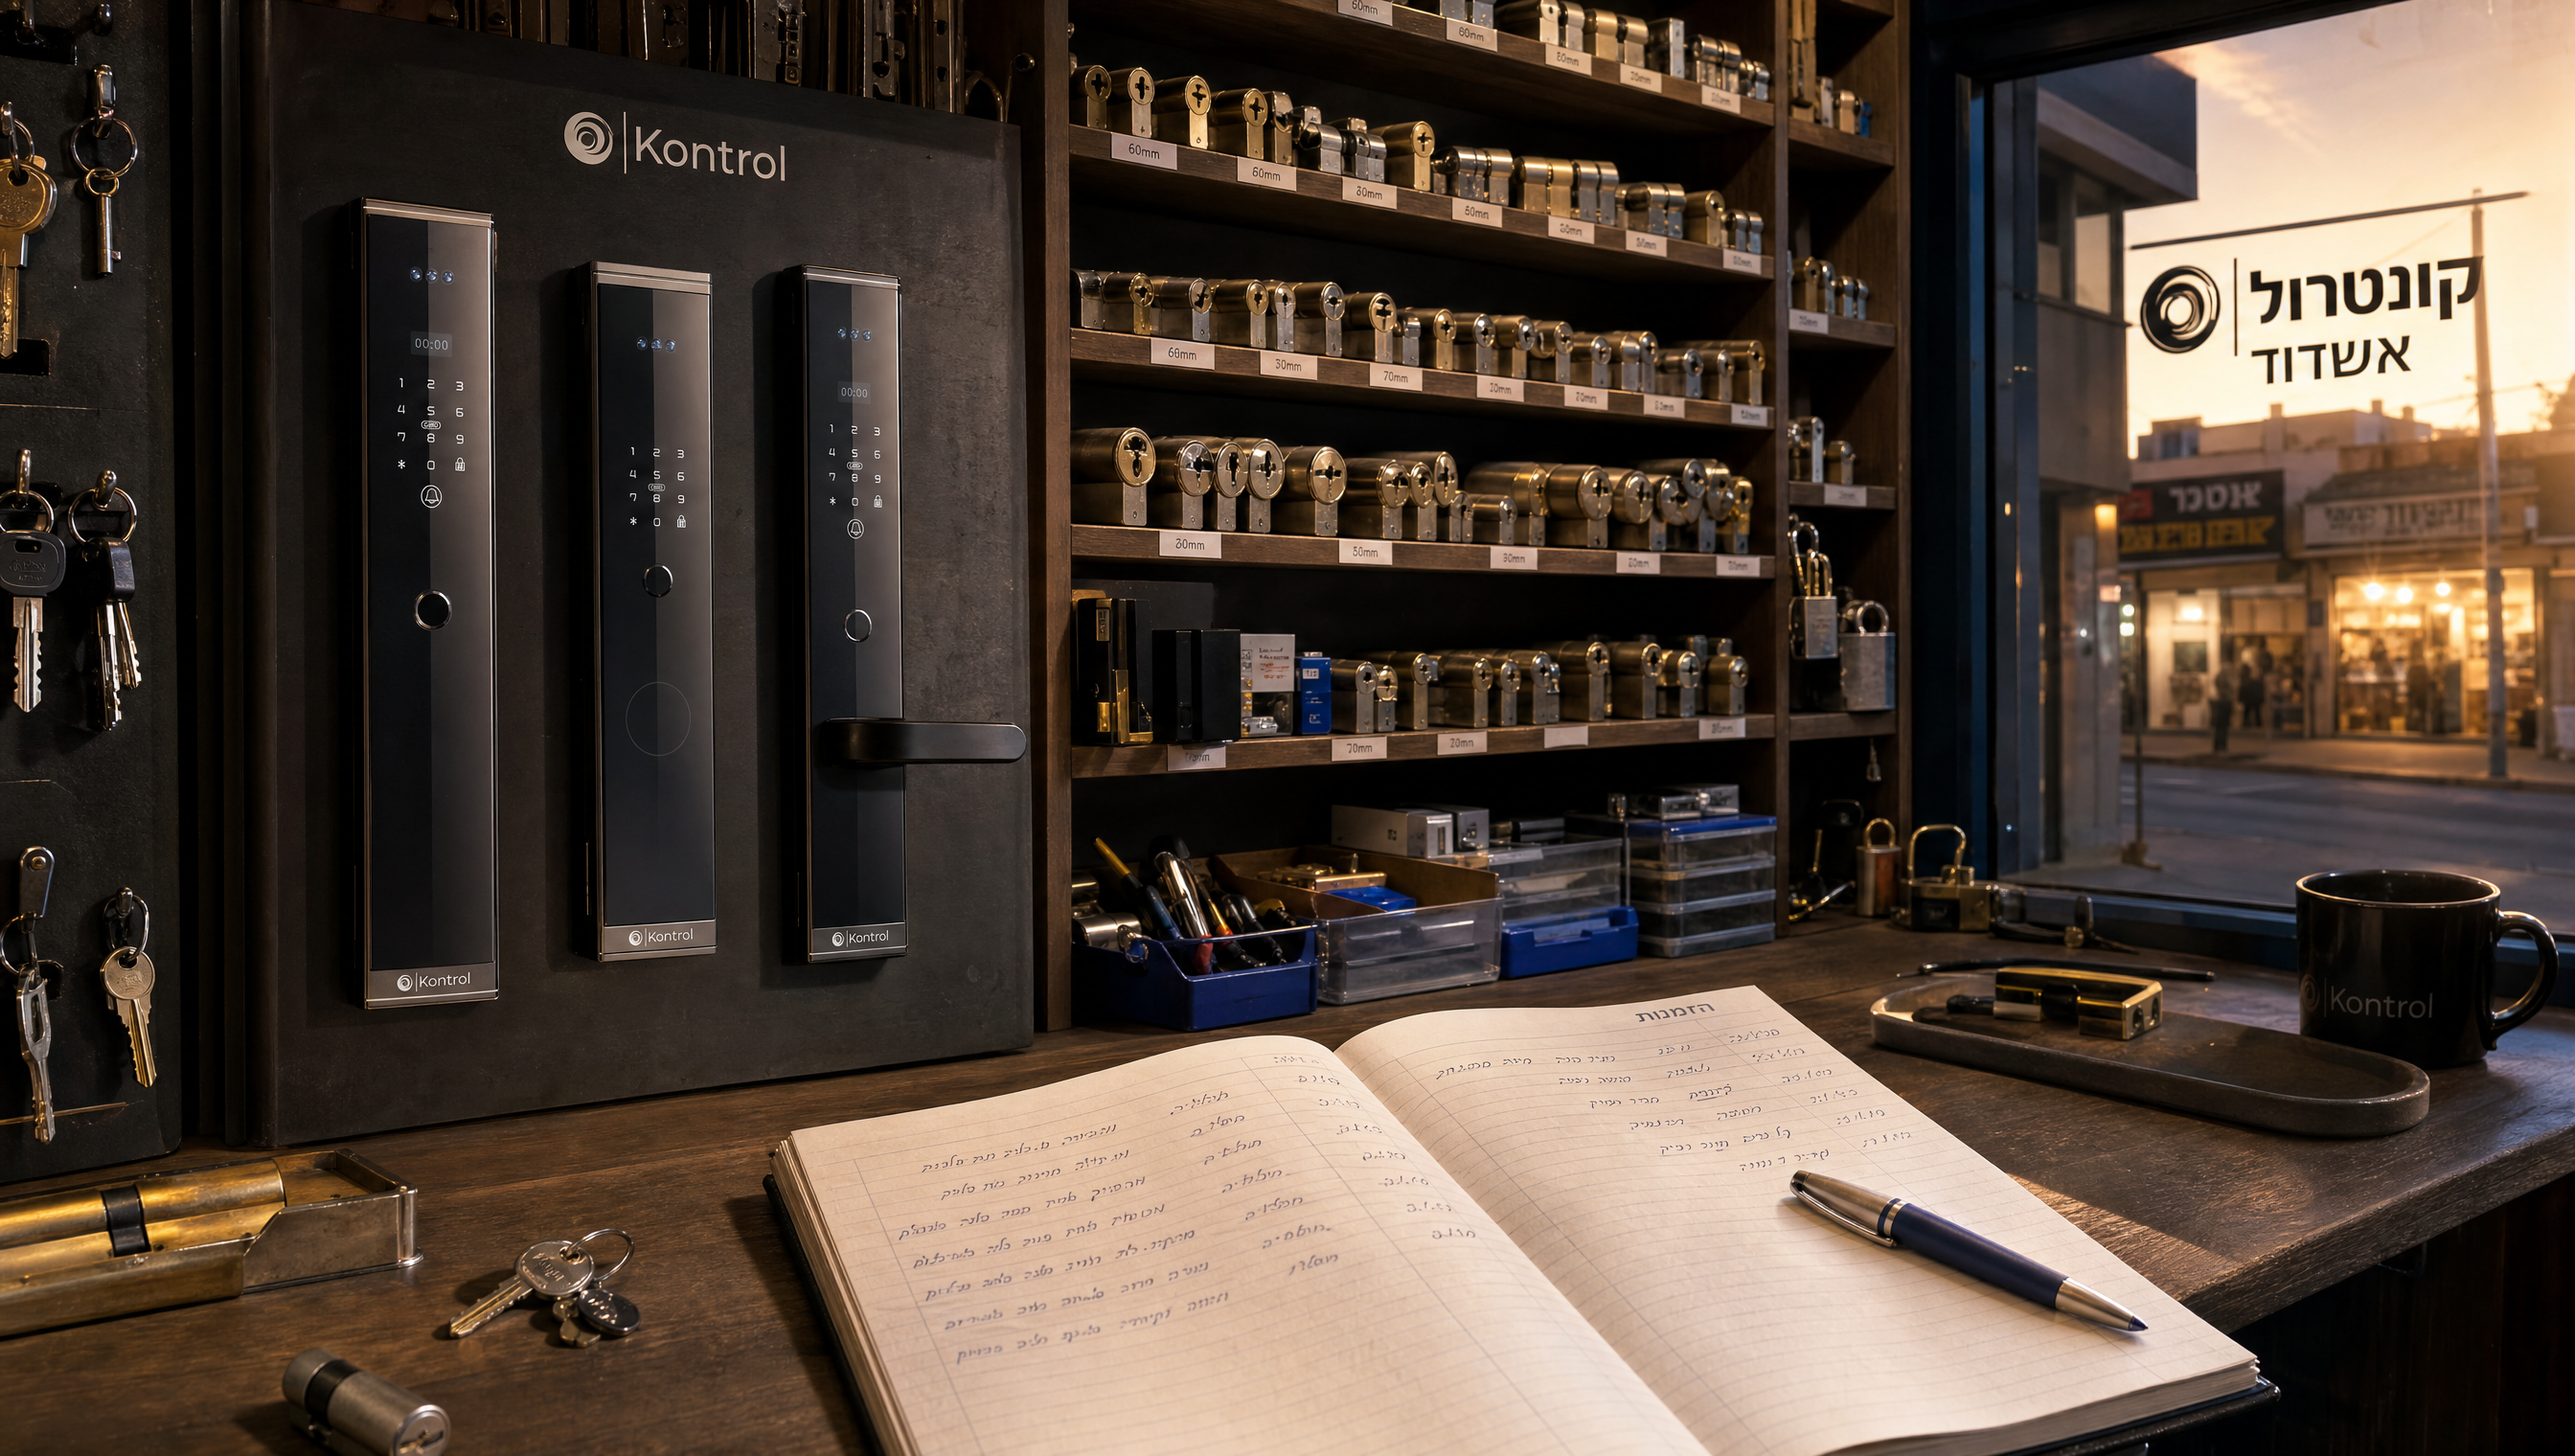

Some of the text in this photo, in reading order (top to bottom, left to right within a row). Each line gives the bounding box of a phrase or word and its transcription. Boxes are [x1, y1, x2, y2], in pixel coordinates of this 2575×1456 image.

[635, 125, 786, 181] Kontrol
[1128, 142, 1160, 160] 60mm
[2249, 256, 2484, 325] קונטרול
[415, 337, 449, 351] 00:00
[1275, 357, 1302, 372] 30mm
[2251, 335, 2411, 385] אשדוד
[1383, 370, 1409, 384] 70mm
[399, 377, 464, 392] 1 2 3
[840, 387, 868, 398] 00:00
[397, 404, 465, 418] 4 5 6
[830, 423, 880, 437] 1 2 3
[397, 431, 465, 444] 7 8 9
[630, 446, 685, 459] 1 2 3
[829, 447, 881, 460] 4 5 6
[426, 460, 436, 470] 0
[628, 469, 685, 482] 4 5 6
[829, 472, 881, 484] 7 8 9
[629, 492, 685, 504] 7 8 9
[852, 497, 859, 507] 0
[653, 517, 661, 527] 0
[1347, 741, 1374, 755] 70mm
[649, 927, 694, 943] Kontrol
[849, 929, 889, 944] Kontrol
[419, 971, 470, 988] Kontrol
[2331, 985, 2433, 1019] Kontrol
[1634, 1002, 1716, 1023] הזמנות
